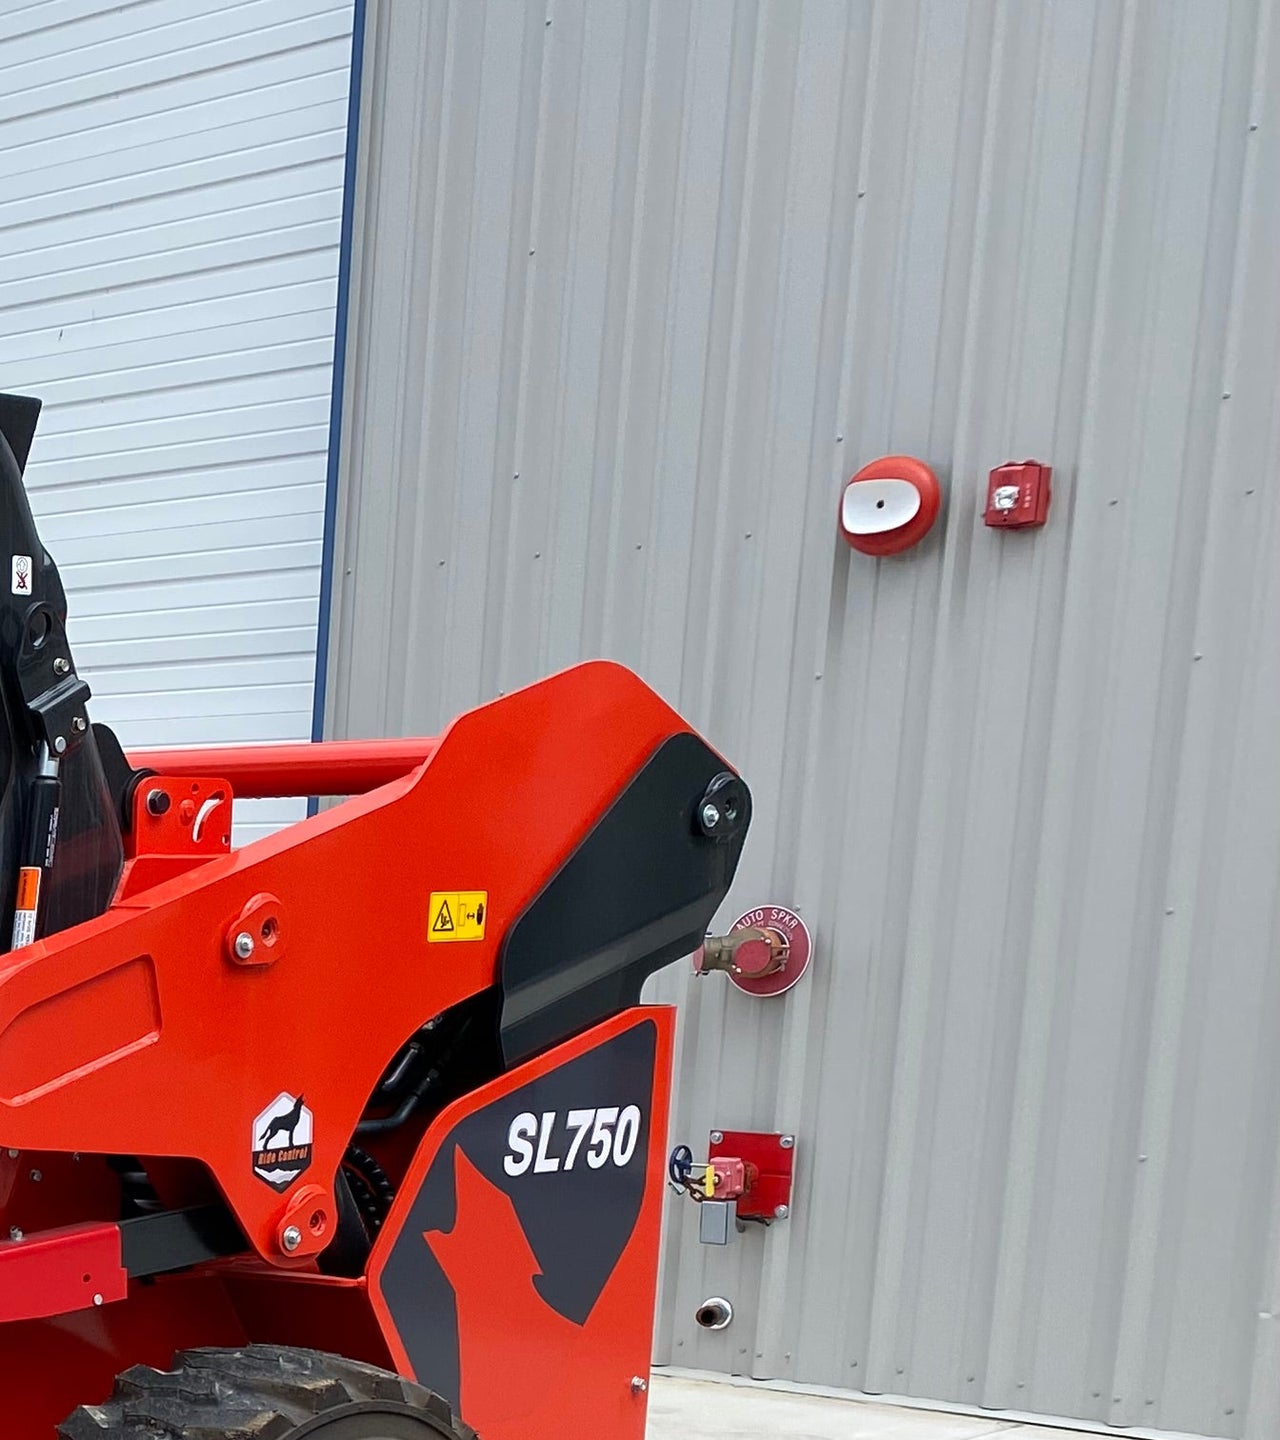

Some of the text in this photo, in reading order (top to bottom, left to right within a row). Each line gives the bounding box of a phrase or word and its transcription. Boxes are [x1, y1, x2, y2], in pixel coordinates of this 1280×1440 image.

[736, 908, 799, 930] AUTO SPKR
[503, 1104, 641, 1177] SL750
[257, 1146, 308, 1165] Ride Control
